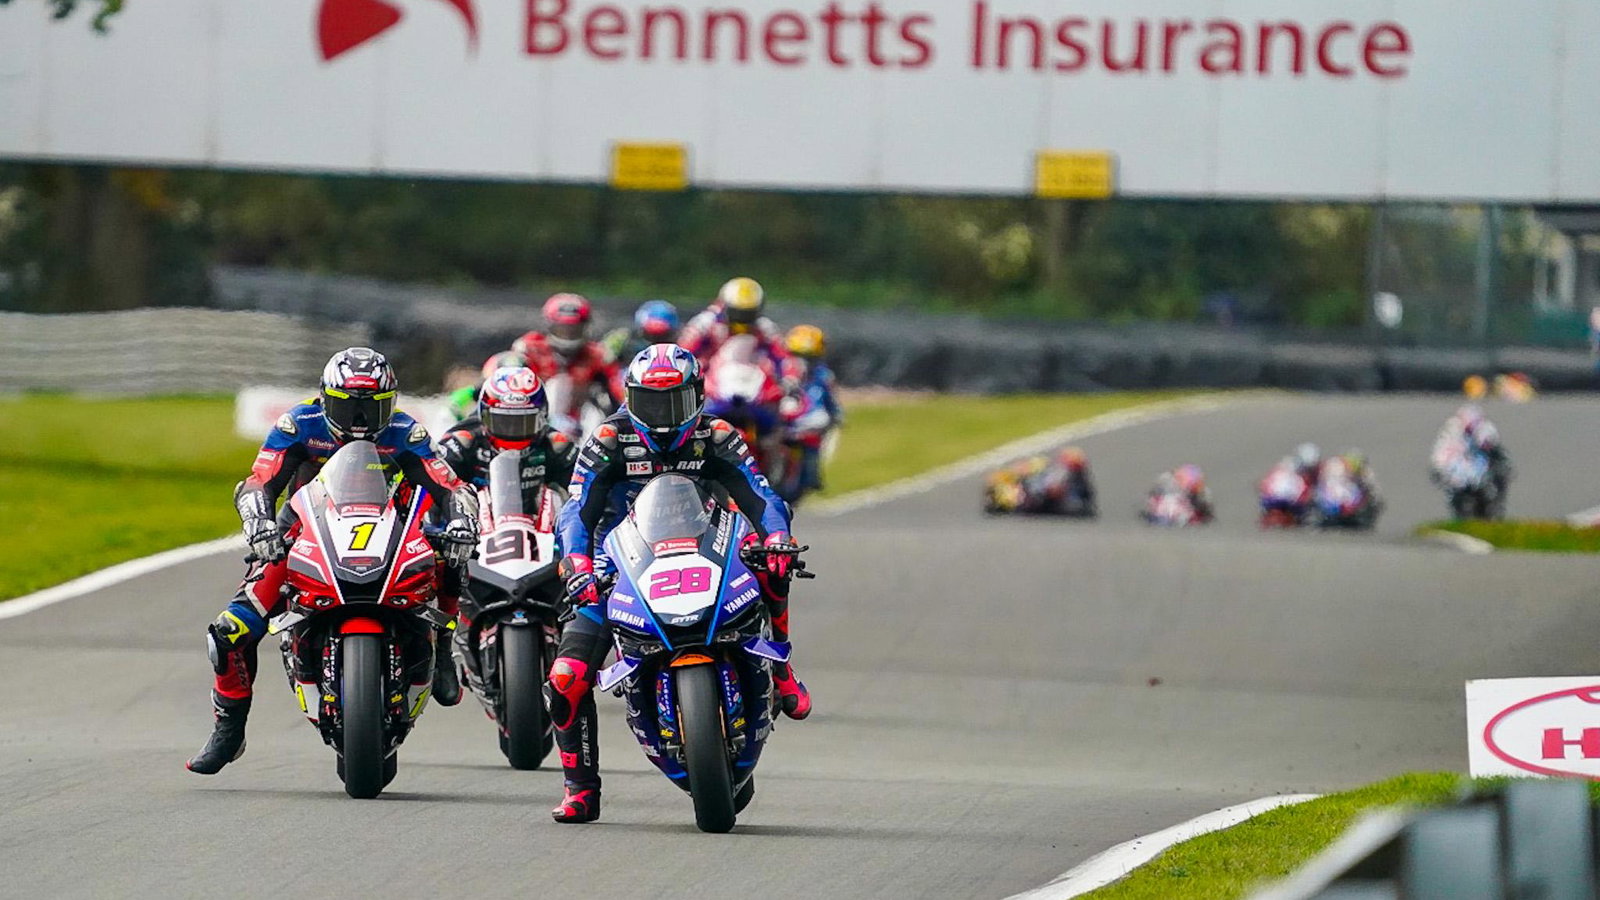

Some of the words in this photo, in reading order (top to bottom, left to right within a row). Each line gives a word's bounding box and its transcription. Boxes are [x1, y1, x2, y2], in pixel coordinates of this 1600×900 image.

[521, 0, 935, 69] Bennetts
[970, 0, 1413, 77] Insurance
[676, 460, 706, 470] RAY
[348, 522, 378, 551] 1
[485, 529, 540, 565] 91
[650, 566, 711, 600] 28
[723, 587, 760, 614] YAMAHA
[611, 608, 645, 628] YAMAHA
